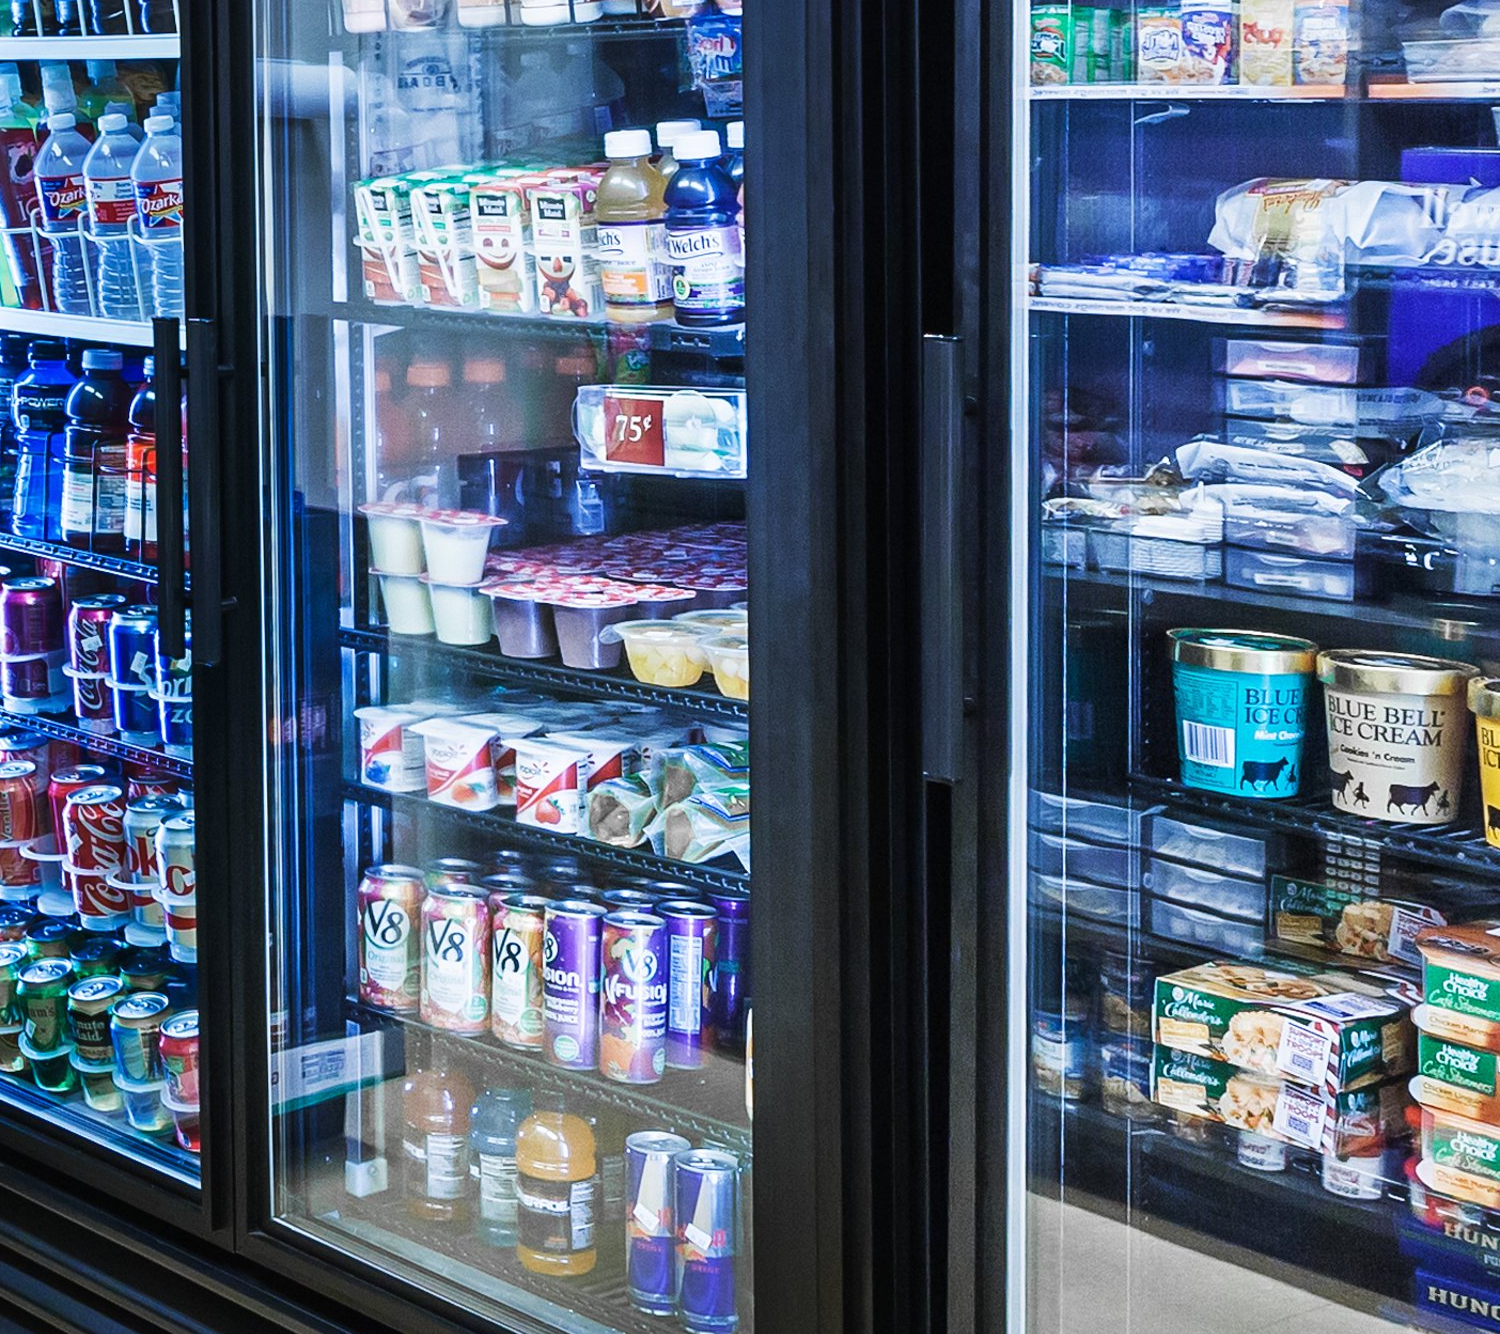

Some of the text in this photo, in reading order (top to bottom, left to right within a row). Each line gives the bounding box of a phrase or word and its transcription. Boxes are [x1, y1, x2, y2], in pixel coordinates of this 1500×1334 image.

[670, 235, 720, 254] Welch's
[614, 413, 652, 444] 75¢
[1245, 688, 1300, 725] BLUE ICE
[1328, 694, 1443, 728] BLUE BELL
[1329, 716, 1443, 748] ICE CREAM
[1340, 743, 1369, 759] Cookies
[1383, 753, 1416, 765] Cream
[366, 898, 405, 945] V8
[428, 917, 466, 963] V8
[494, 927, 522, 974] V8
[1443, 979, 1487, 1001] Choice
[1449, 972, 1489, 992] Healthy
[1182, 990, 1216, 1011] Marie
[1435, 1050, 1479, 1073] Choice
[1442, 1043, 1481, 1063] Healthy
[1450, 1138, 1496, 1161] Choice
[1457, 1131, 1498, 1150] Healthy
